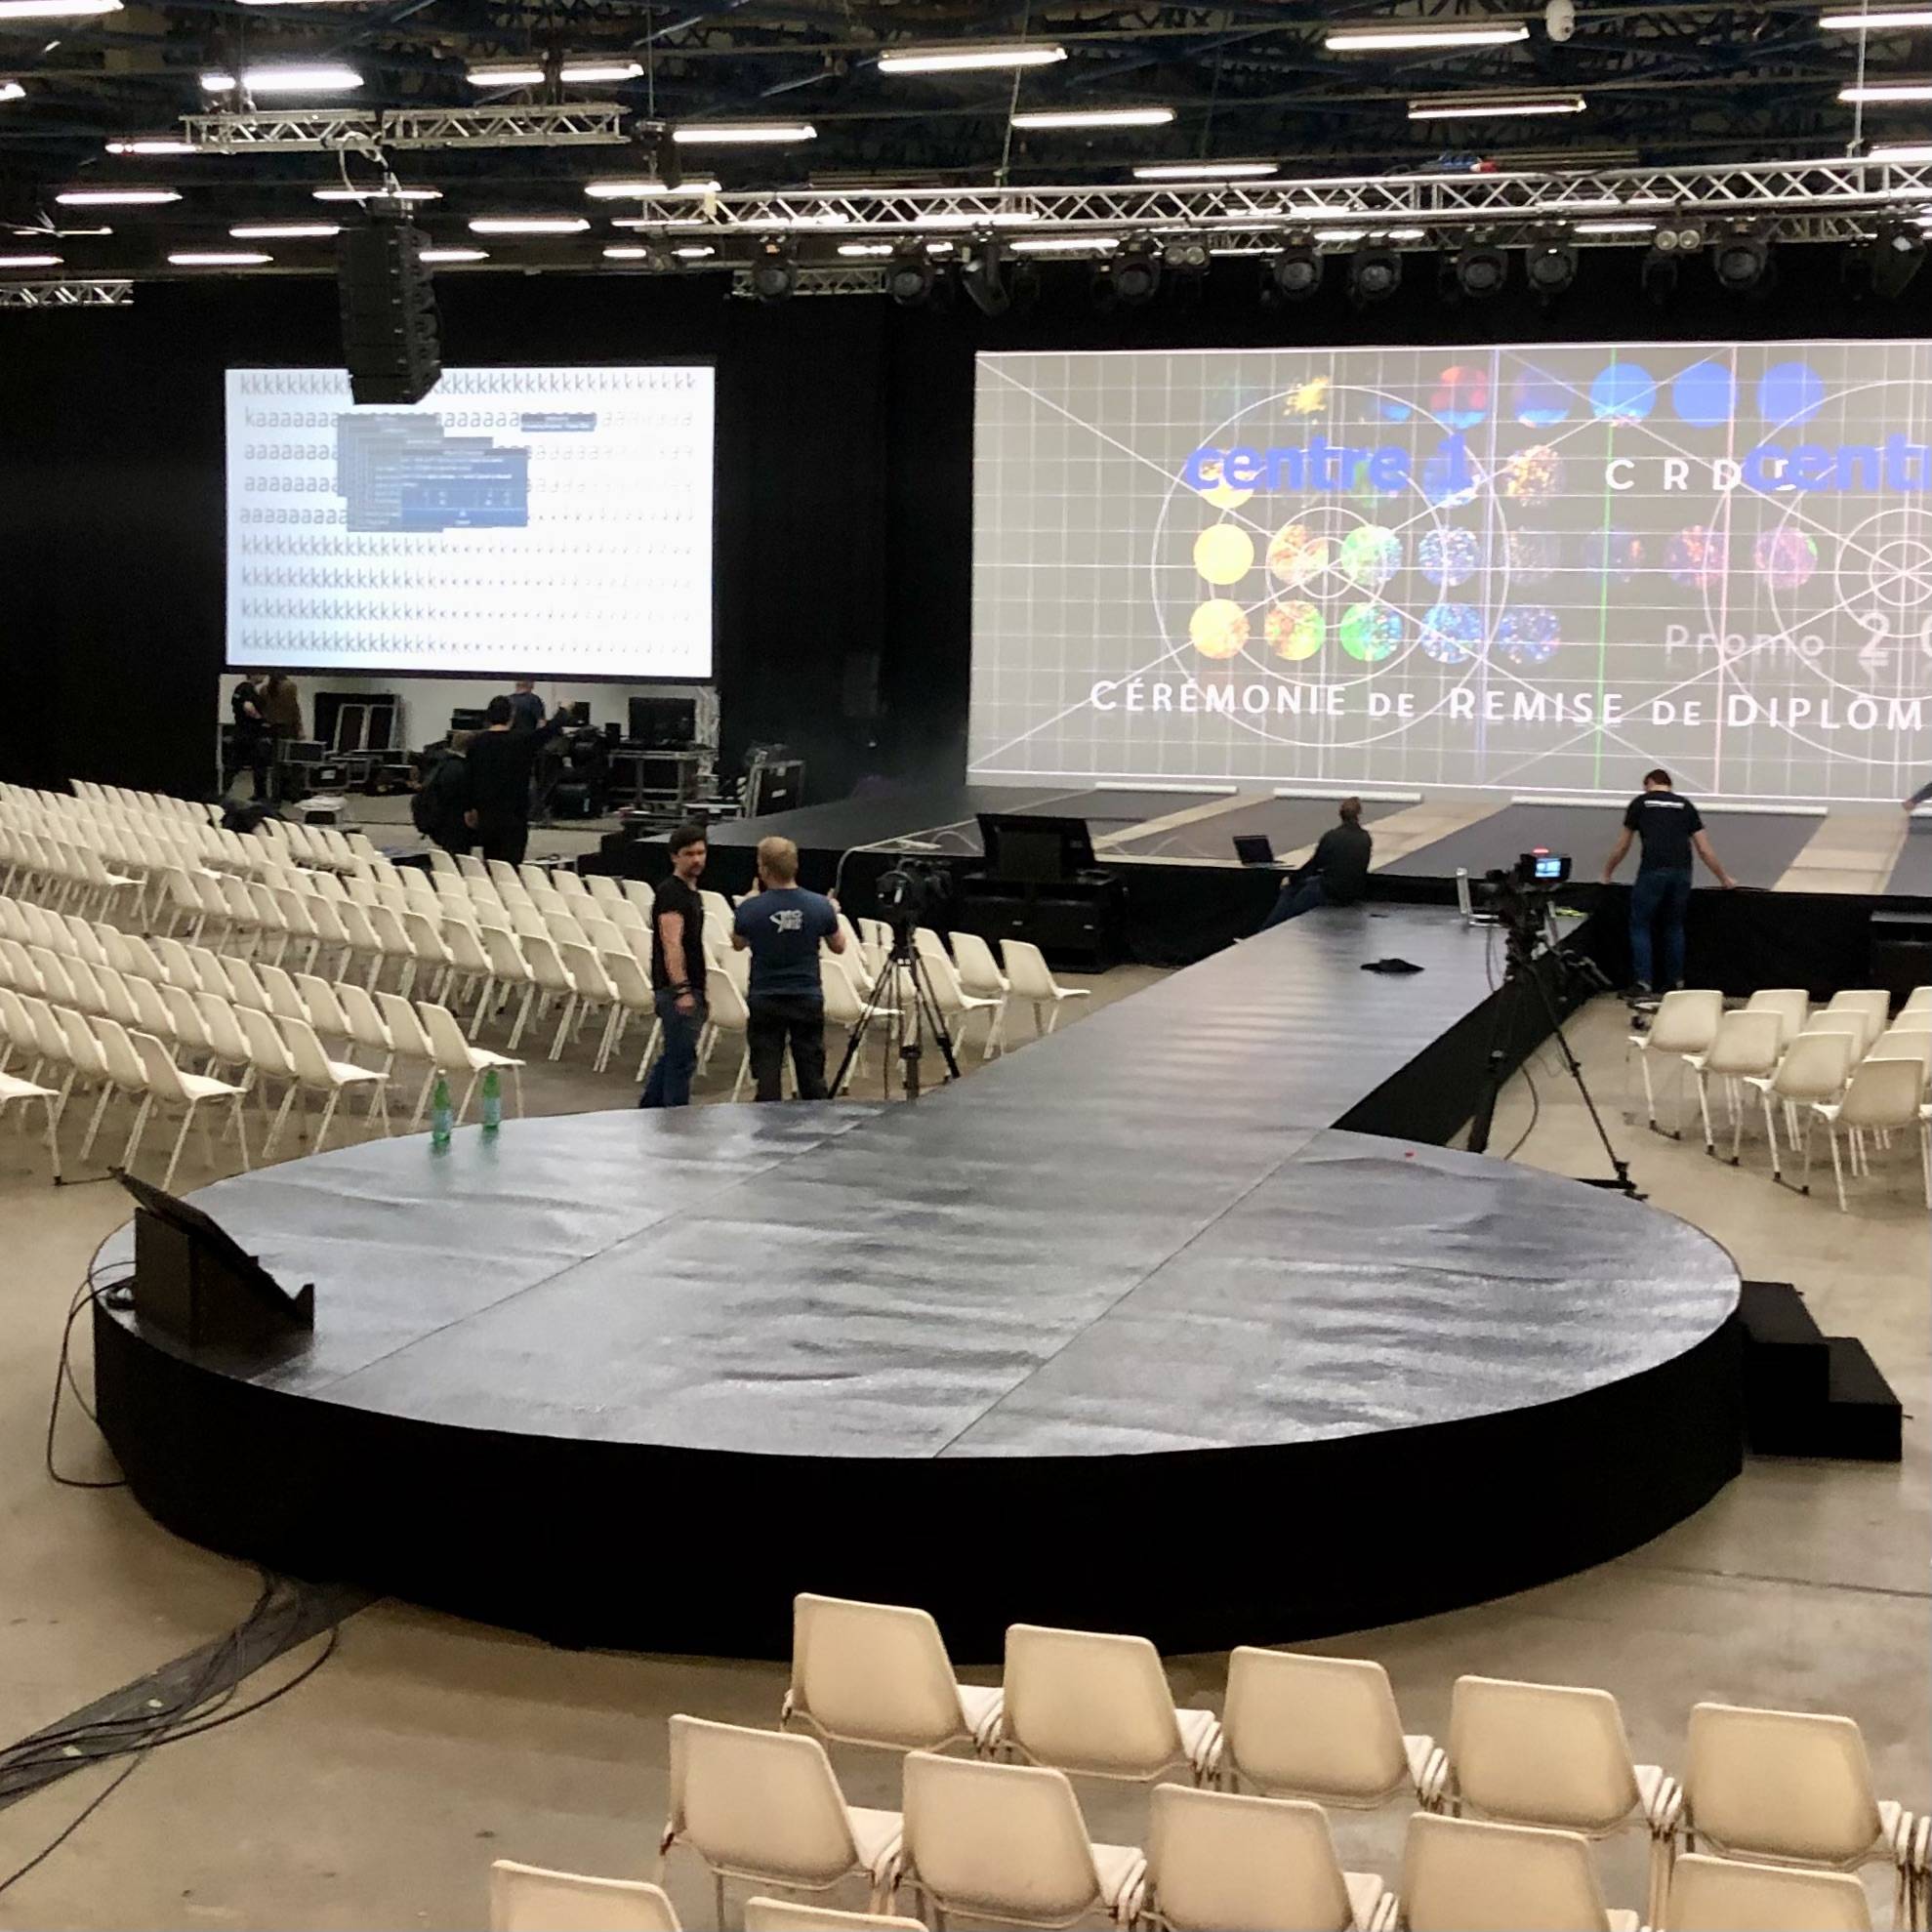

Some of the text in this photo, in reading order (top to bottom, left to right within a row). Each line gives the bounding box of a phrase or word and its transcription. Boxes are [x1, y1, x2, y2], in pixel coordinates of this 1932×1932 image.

[1186, 435, 1410, 491] centre
[1665, 624, 1825, 657] Promo
[1090, 677, 1346, 717] CÉRÉMONIE
[1369, 692, 1416, 718] DE
[1449, 686, 1624, 723] REMISE
[1652, 700, 1702, 726] DE
